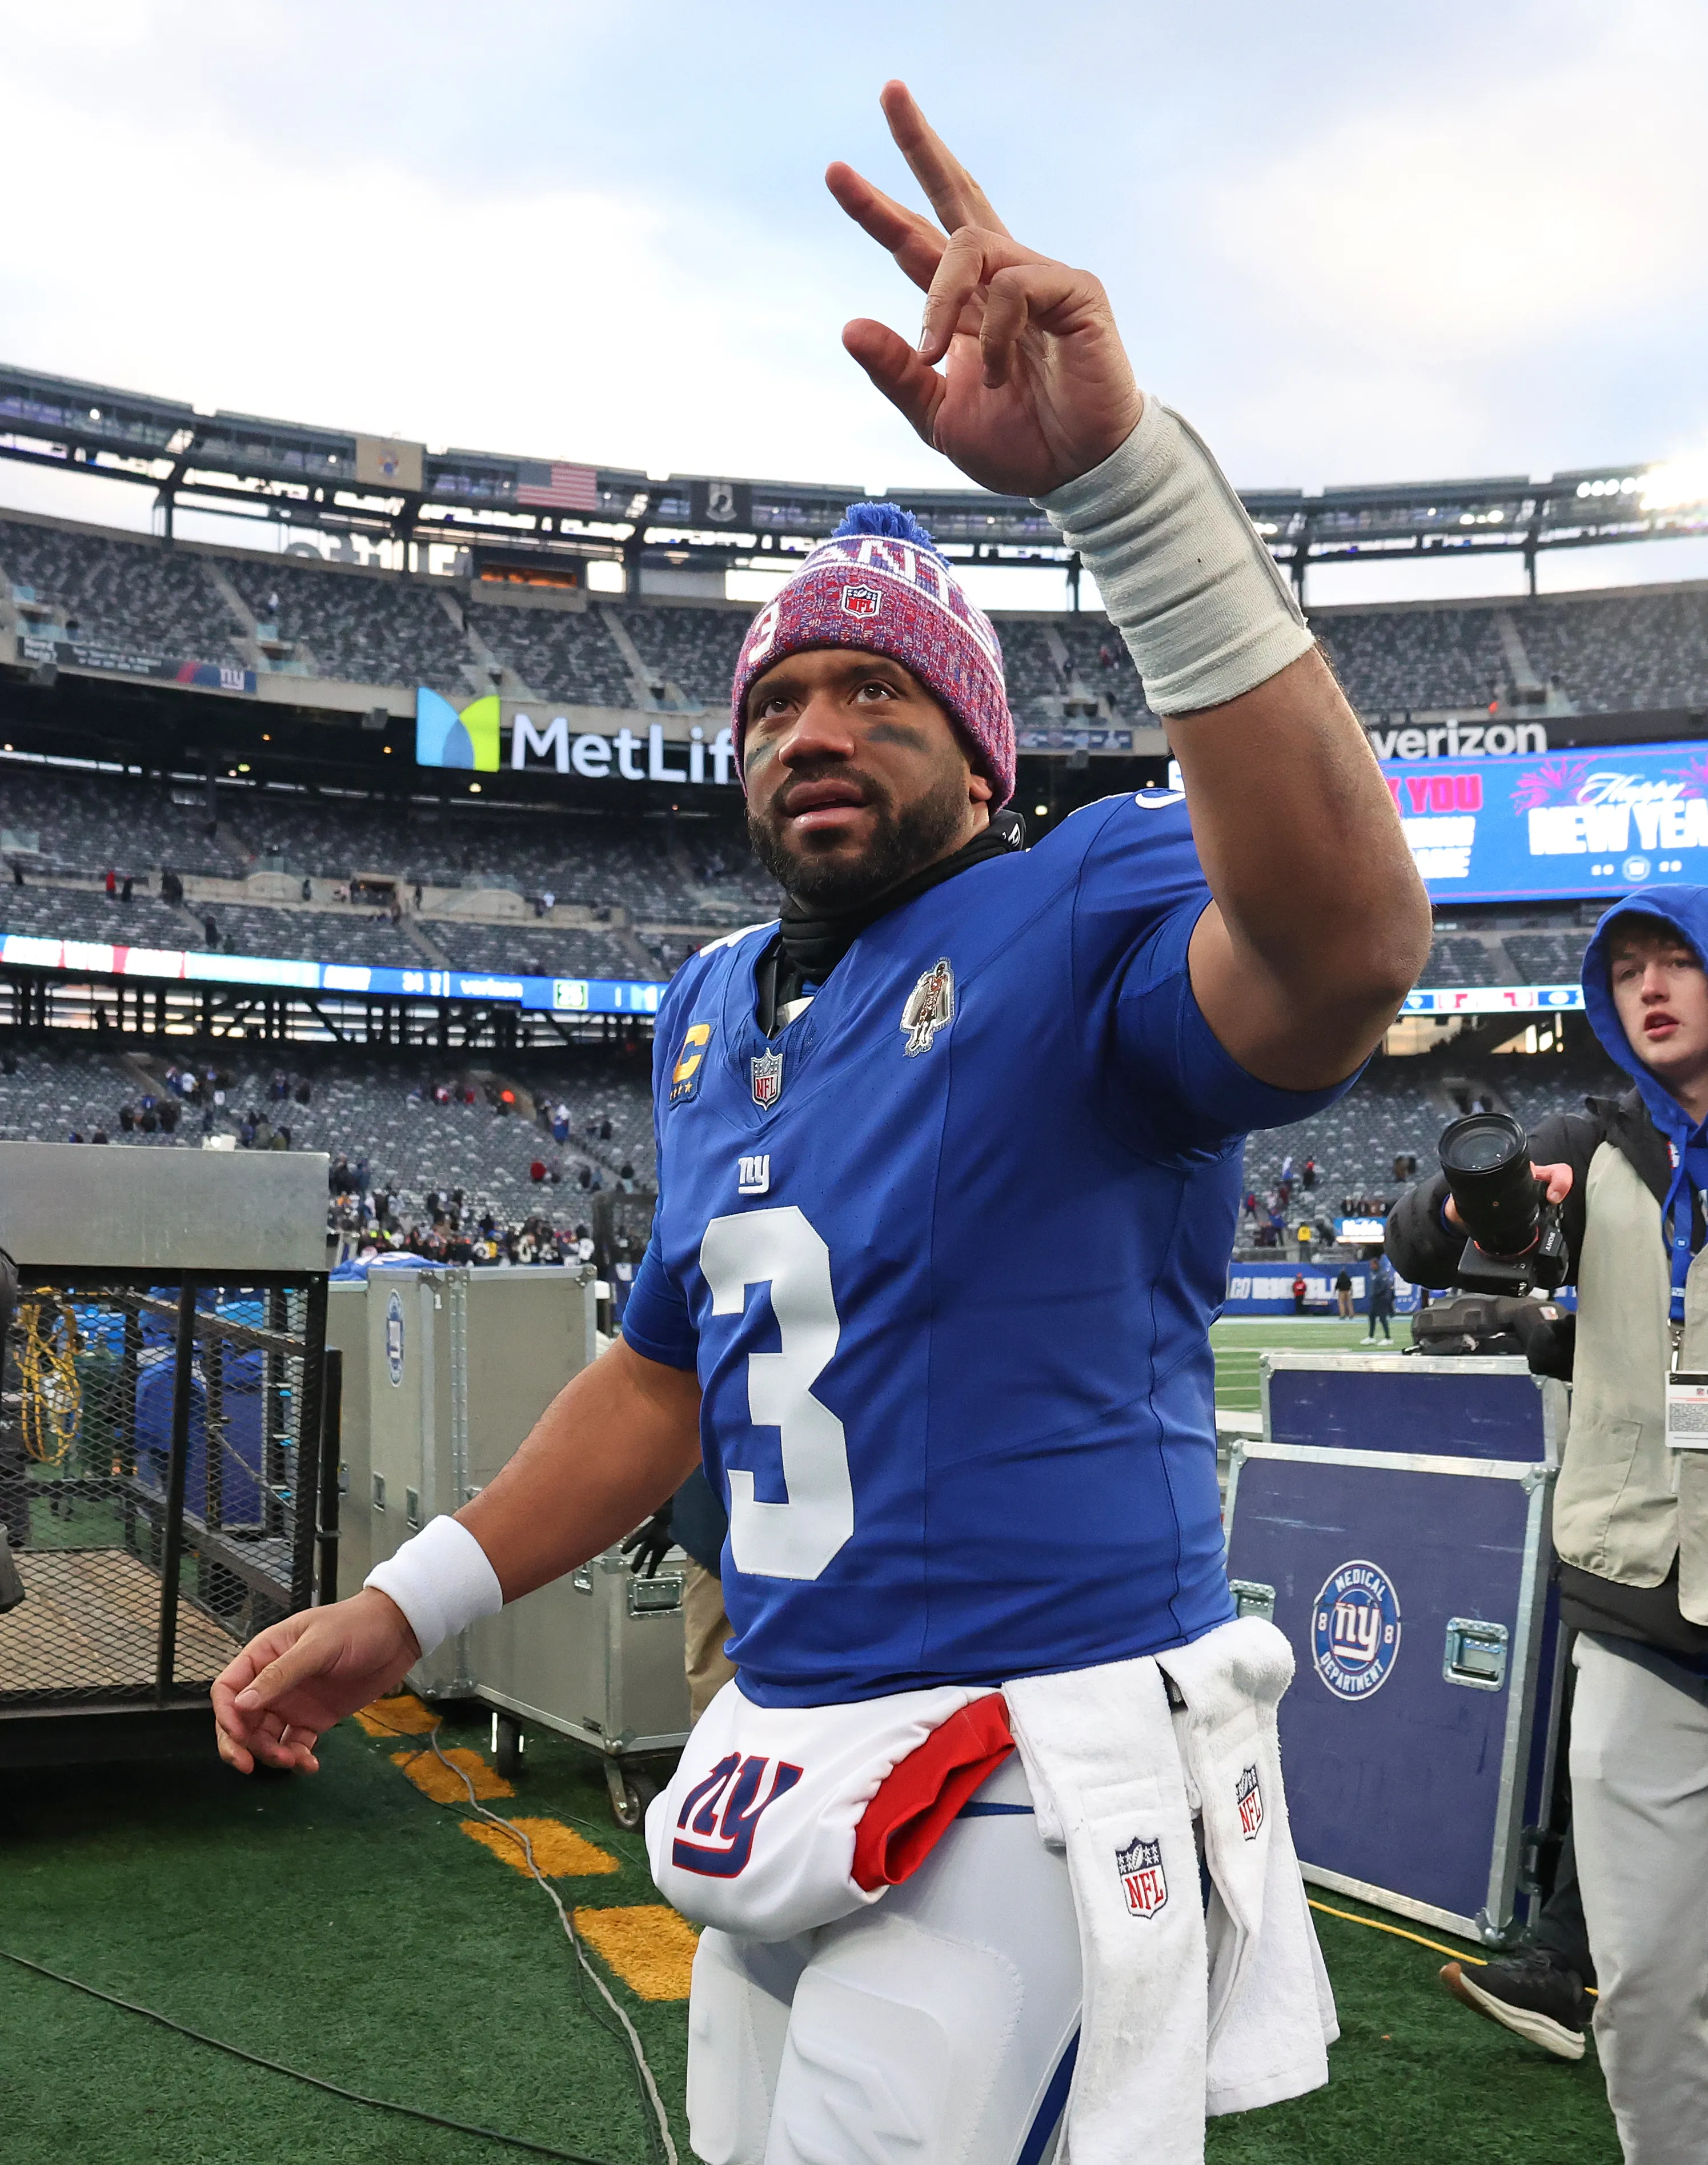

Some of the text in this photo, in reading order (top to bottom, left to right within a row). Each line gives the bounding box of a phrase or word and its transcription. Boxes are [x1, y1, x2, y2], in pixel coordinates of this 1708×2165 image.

[848, 598, 873, 613] NFL
[748, 602, 780, 663] 3
[511, 713, 734, 784] MetLif
[1372, 720, 1547, 759] verizon
[1405, 774, 1483, 814] YOU
[1577, 772, 1686, 805] Happy
[1529, 804, 1630, 855] NEW
[1632, 799, 1708, 849] YEA
[673, 1024, 709, 1084] C
[755, 1077, 776, 1102] NFL
[738, 1154, 770, 1194] ny
[1545, 1232, 1556, 1252] SONY
[700, 1205, 854, 1581] 3
[1334, 1569, 1386, 1602] MEDICAL
[1320, 1651, 1384, 1692] DEPARTMENT
[1238, 1791, 1261, 1834] NFL
[1125, 1869, 1164, 1910] NFL
